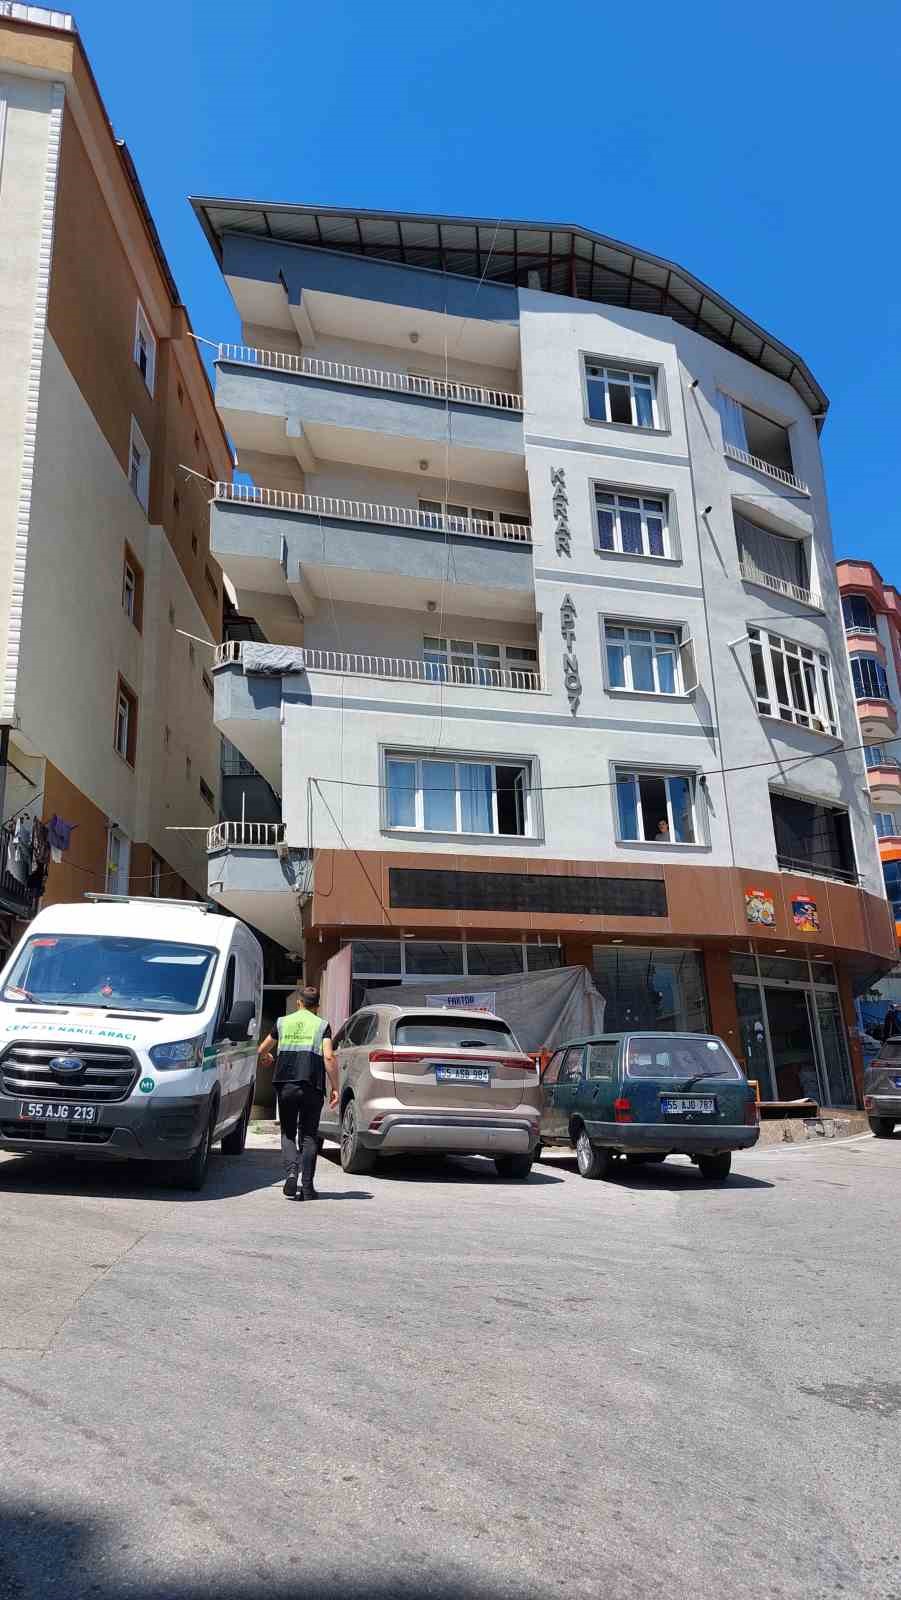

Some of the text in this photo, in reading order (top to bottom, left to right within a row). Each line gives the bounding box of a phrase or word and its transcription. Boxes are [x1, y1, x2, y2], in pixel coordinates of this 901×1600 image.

[28, 1103, 95, 1120] 55 AJG 213
